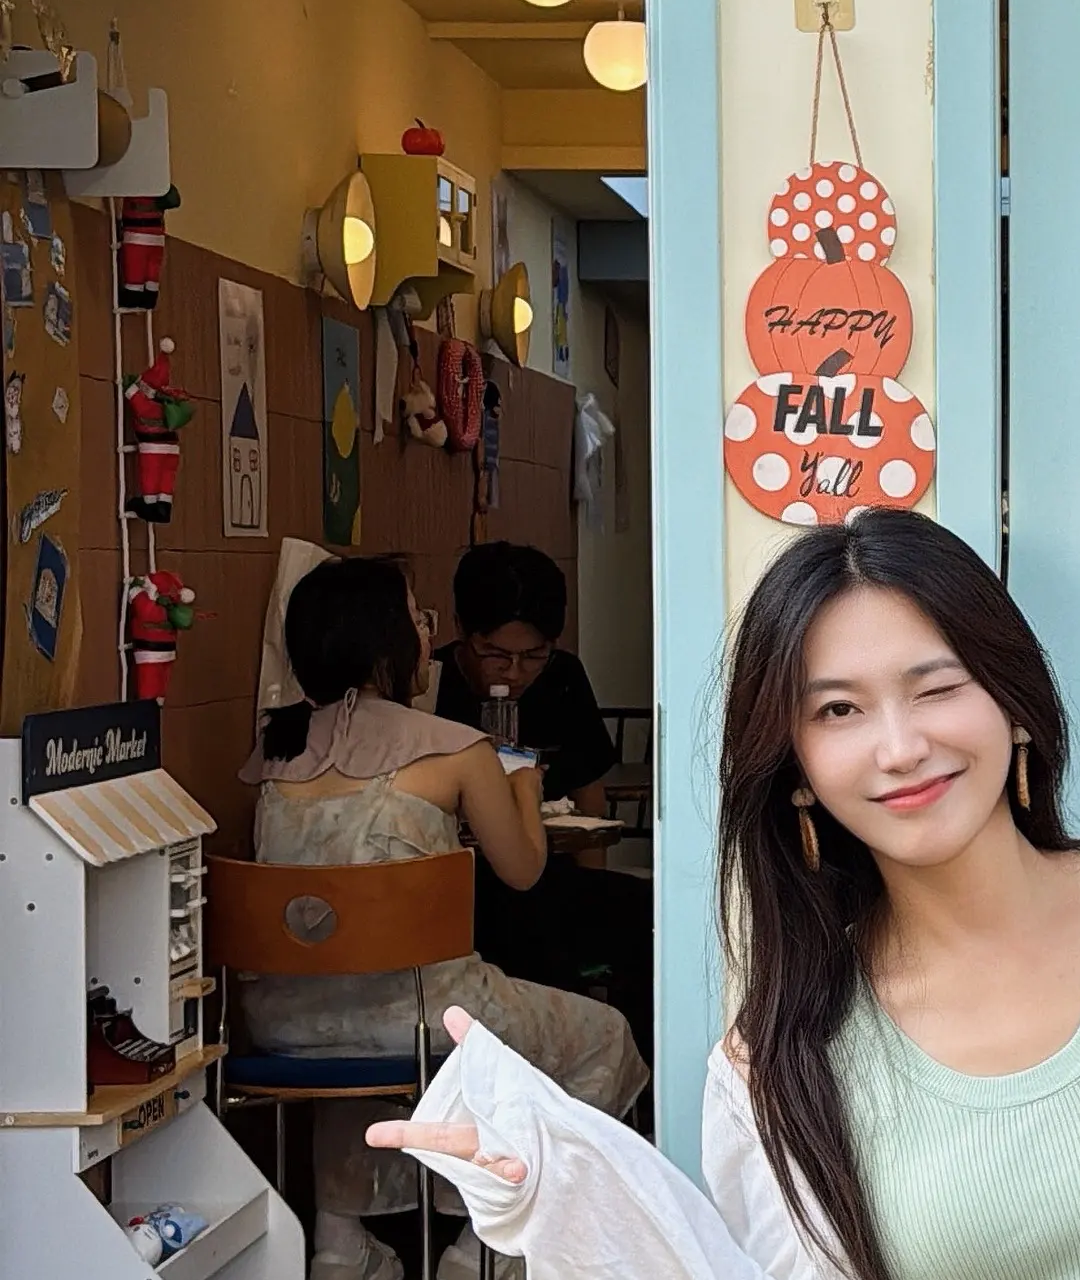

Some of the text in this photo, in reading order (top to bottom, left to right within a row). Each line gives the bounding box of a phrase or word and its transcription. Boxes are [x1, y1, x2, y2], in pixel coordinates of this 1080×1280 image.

[763, 305, 898, 349] HAPPY
[773, 383, 885, 438] FALL
[105, 726, 148, 764] Market
[137, 1091, 166, 1128] OPEN
